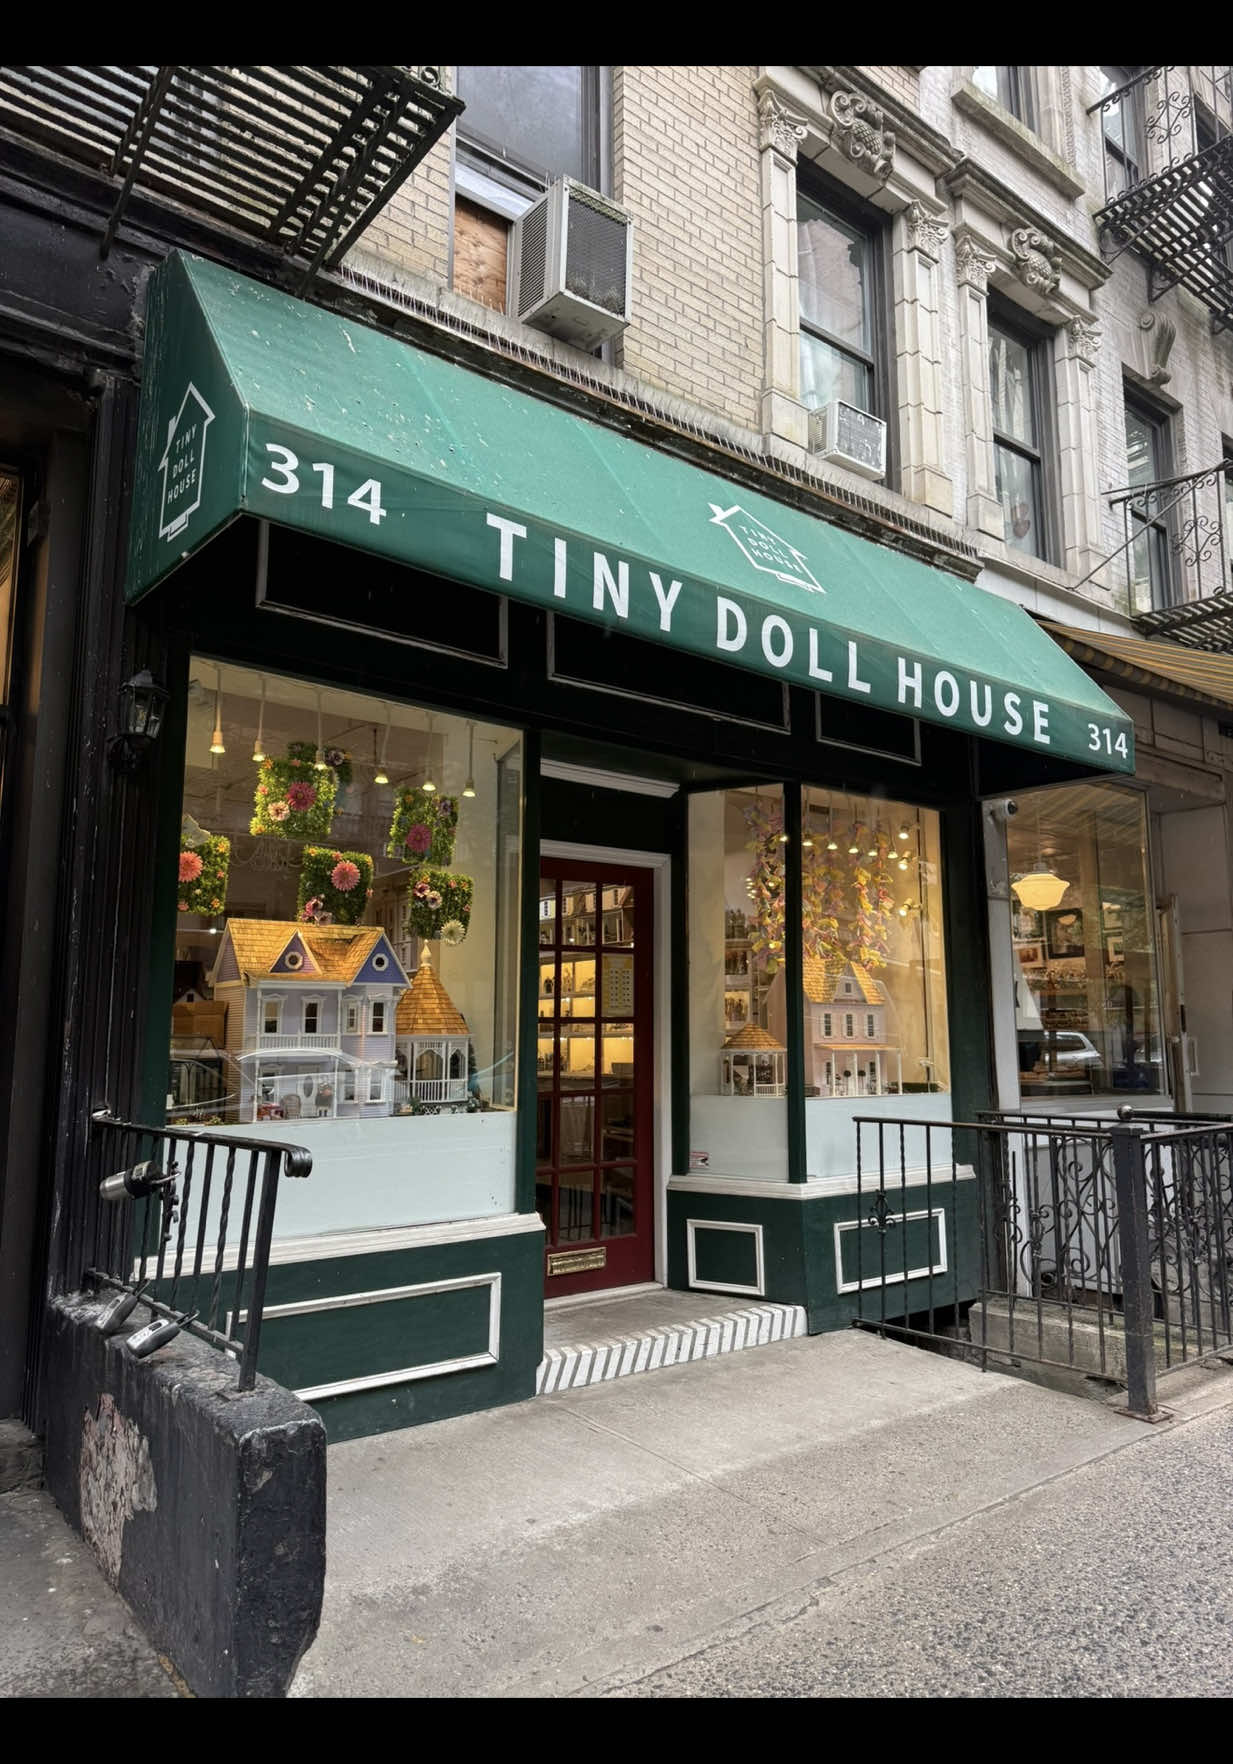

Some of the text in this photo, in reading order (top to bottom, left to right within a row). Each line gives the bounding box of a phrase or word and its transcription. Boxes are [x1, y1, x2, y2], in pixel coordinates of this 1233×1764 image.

[175, 423, 197, 453] TINY
[172, 450, 195, 478] DOLL
[167, 468, 197, 504] HOUSE
[261, 443, 387, 525] 314
[738, 525, 777, 546] TINY
[747, 537, 789, 559] DOLL
[751, 548, 803, 574] HOUSE
[486, 512, 1051, 745] TINY DOLL HOUSE
[1087, 723, 1129, 759] 314
